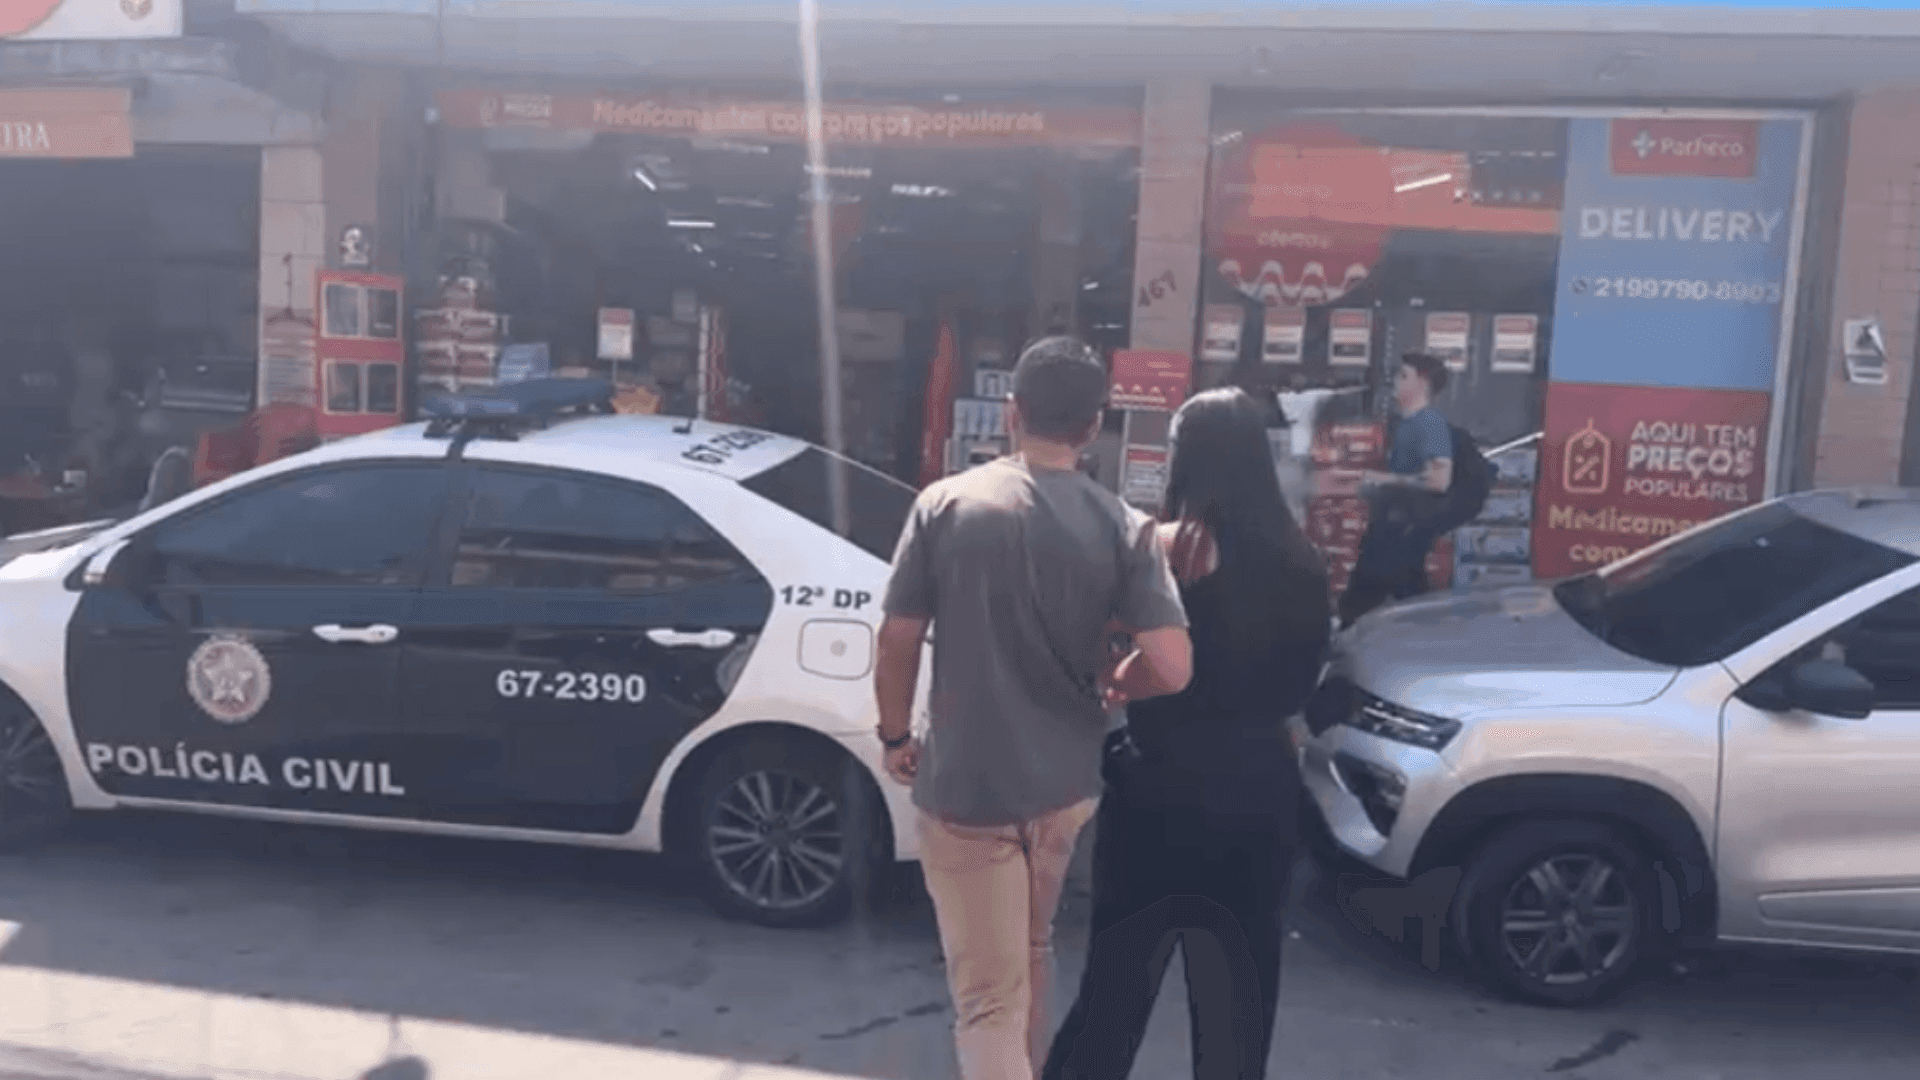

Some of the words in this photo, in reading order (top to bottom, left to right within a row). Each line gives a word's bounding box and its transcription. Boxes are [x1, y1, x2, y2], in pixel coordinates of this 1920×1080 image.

[1579, 206, 1783, 242] DELIVERY
[1631, 420, 1697, 443] AQUI
[1704, 424, 1756, 449] TEM
[1627, 444, 1754, 480] PREÇOS
[1623, 477, 1748, 502] POPULARES
[833, 588, 872, 609] DP
[497, 669, 646, 702] 67-2390
[87, 742, 269, 785] POLÍCIA
[282, 757, 405, 795] CIVIL
